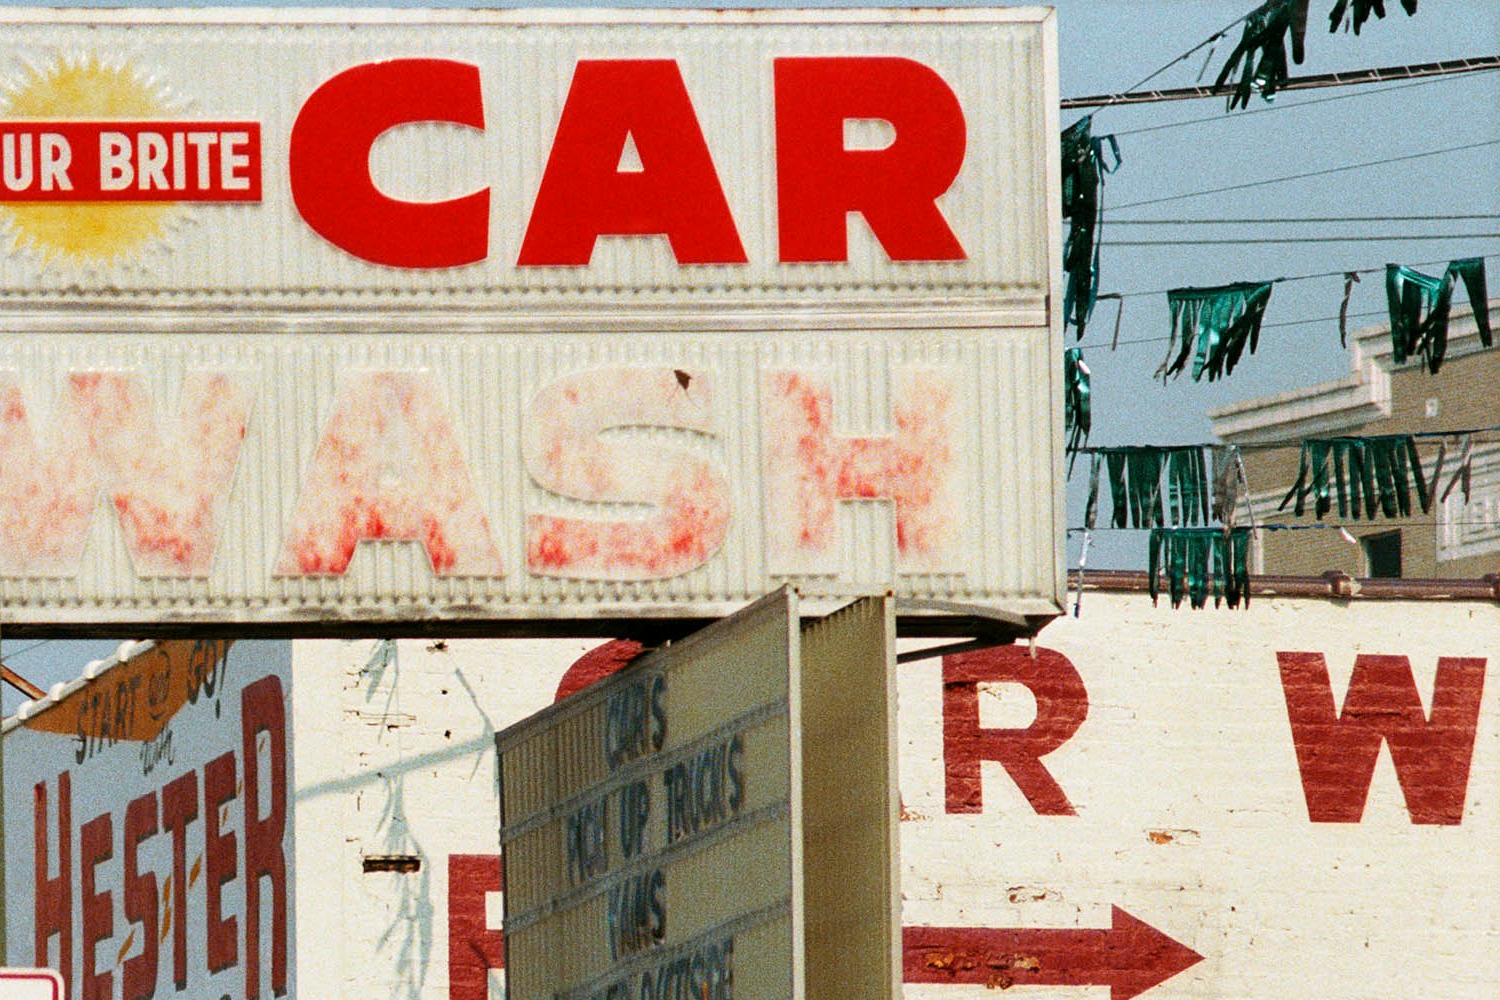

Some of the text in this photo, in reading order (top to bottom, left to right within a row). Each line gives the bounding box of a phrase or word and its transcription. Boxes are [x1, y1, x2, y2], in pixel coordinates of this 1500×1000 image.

[100, 131, 250, 191] BRITE
[289, 56, 967, 269] CAR
[74, 675, 142, 765] START
[619, 780, 649, 858] UP
